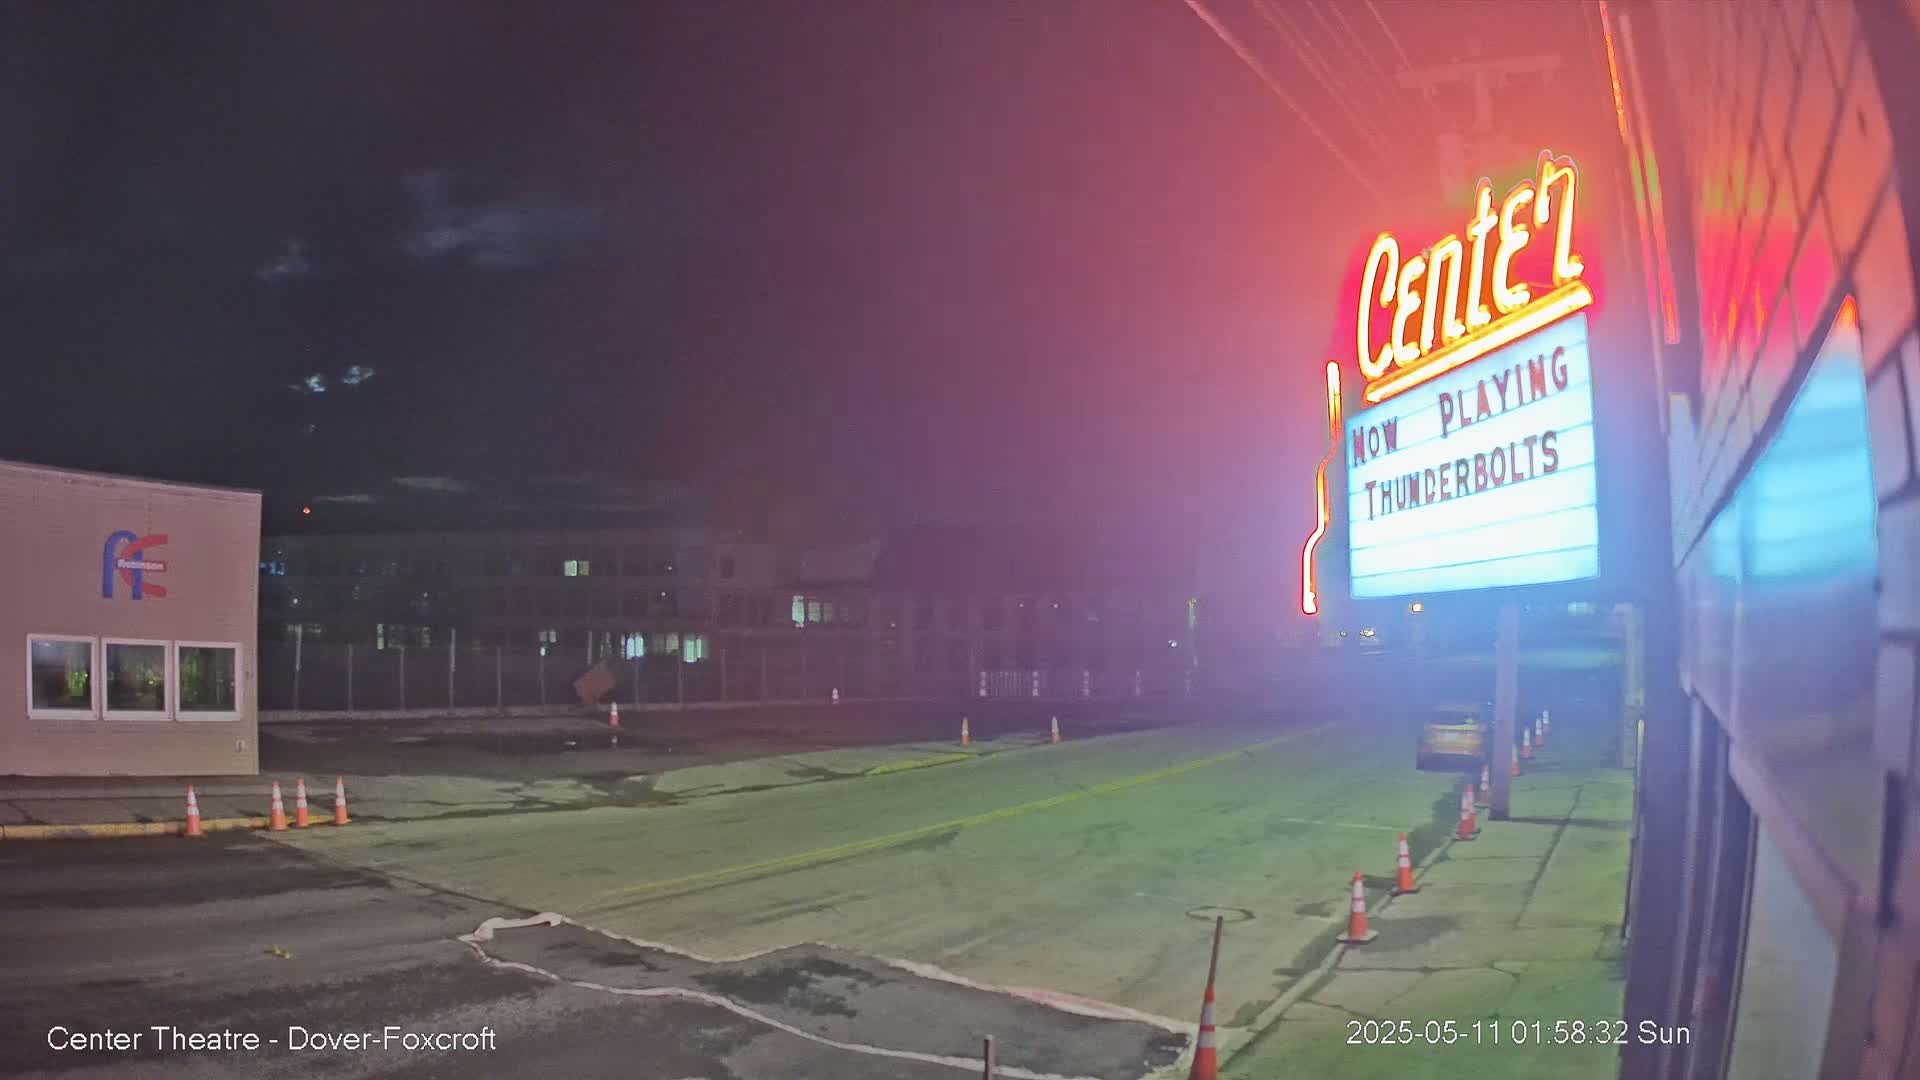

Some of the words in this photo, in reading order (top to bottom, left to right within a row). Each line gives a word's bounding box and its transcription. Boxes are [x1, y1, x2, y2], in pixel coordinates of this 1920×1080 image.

[1352, 416, 1397, 467] NOW
[1439, 346, 1568, 439] PLAYING
[1365, 430, 1559, 521] THUNDERBOLTS
